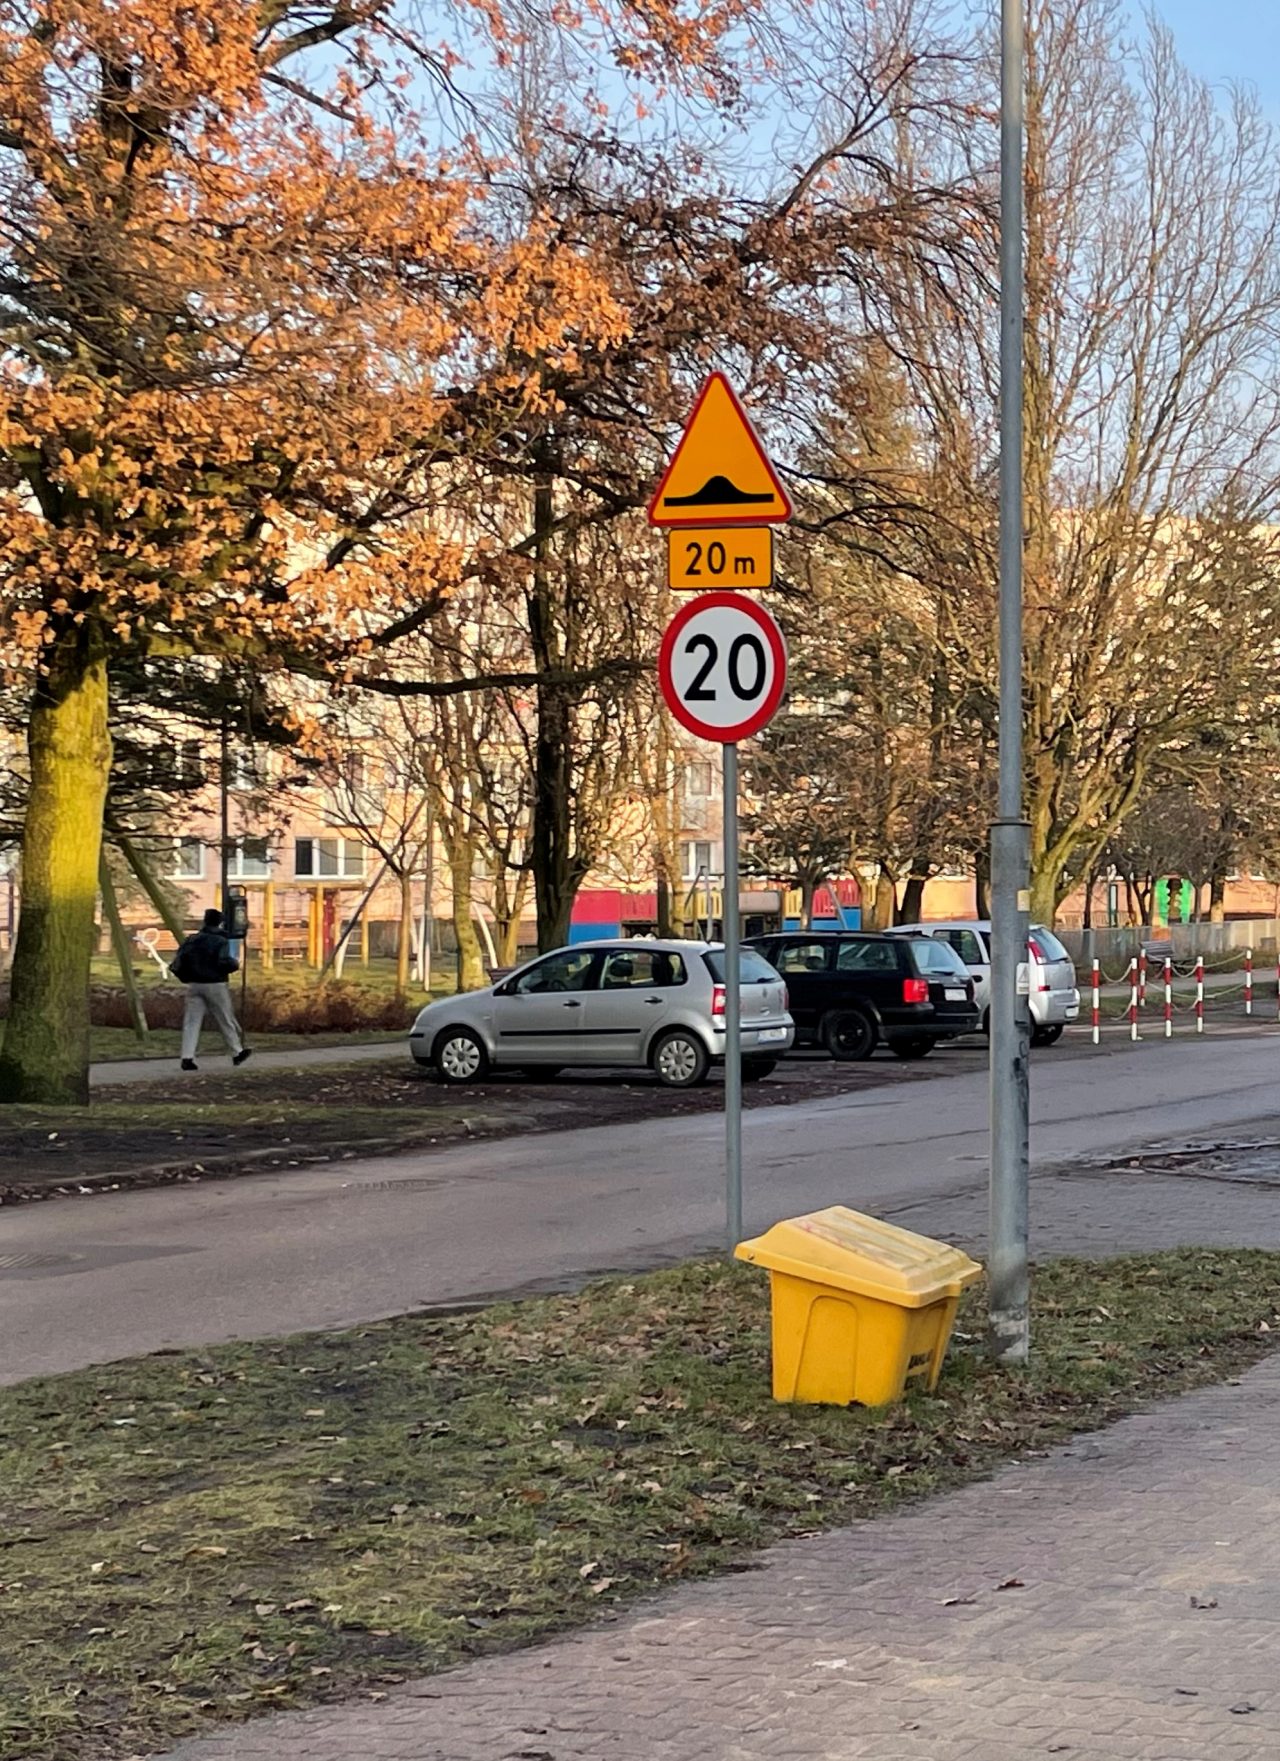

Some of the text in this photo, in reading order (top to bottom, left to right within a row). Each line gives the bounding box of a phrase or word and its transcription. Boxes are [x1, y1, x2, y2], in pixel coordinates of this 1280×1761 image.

[685, 541, 755, 575] 20 m
[684, 633, 766, 701] 20
